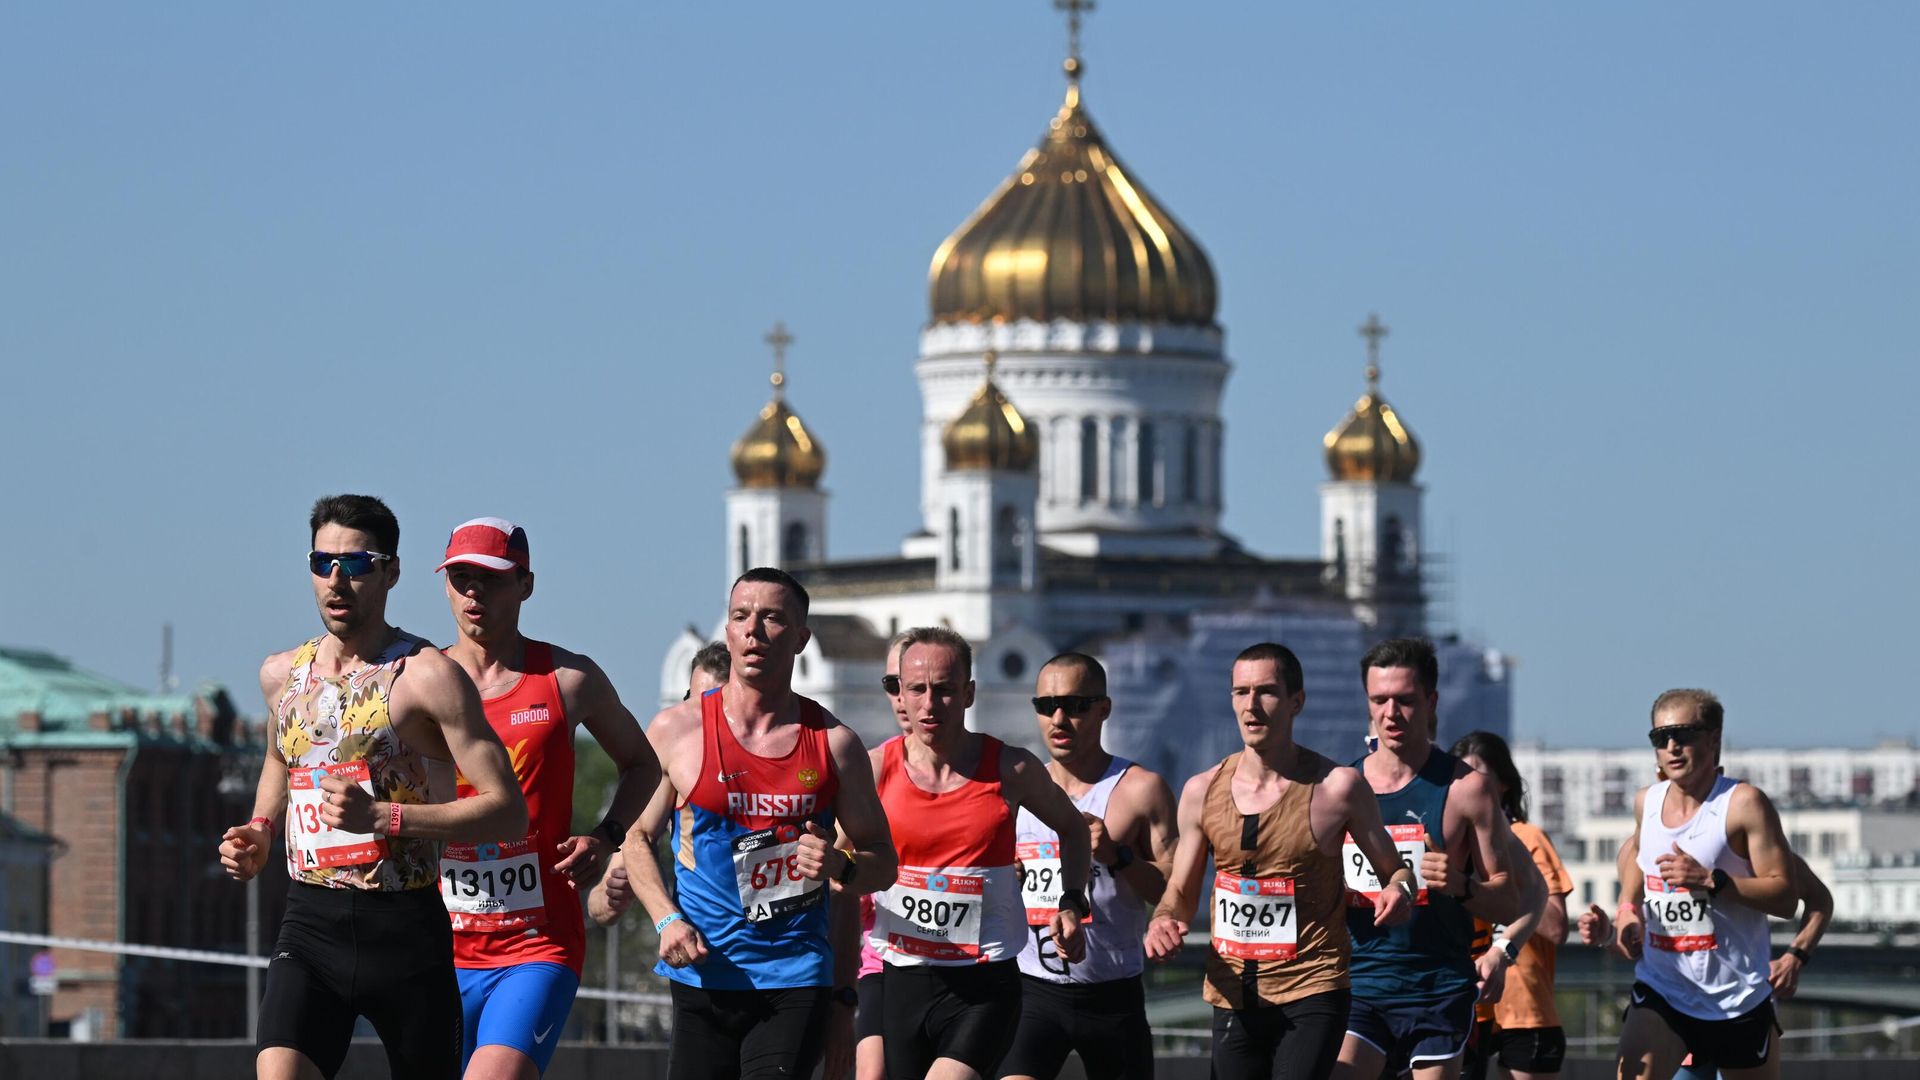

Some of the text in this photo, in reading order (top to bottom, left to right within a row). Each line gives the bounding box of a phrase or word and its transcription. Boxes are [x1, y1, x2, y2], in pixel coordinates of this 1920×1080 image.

[511, 709, 549, 726] BORODA
[728, 792, 817, 817] RUSSIA
[445, 863, 537, 898] 13190
[902, 895, 970, 928] 9807
[1219, 898, 1293, 928] 12967
[1645, 899, 1707, 922] 11687
[916, 925, 949, 937] СЕРГЕЙ
